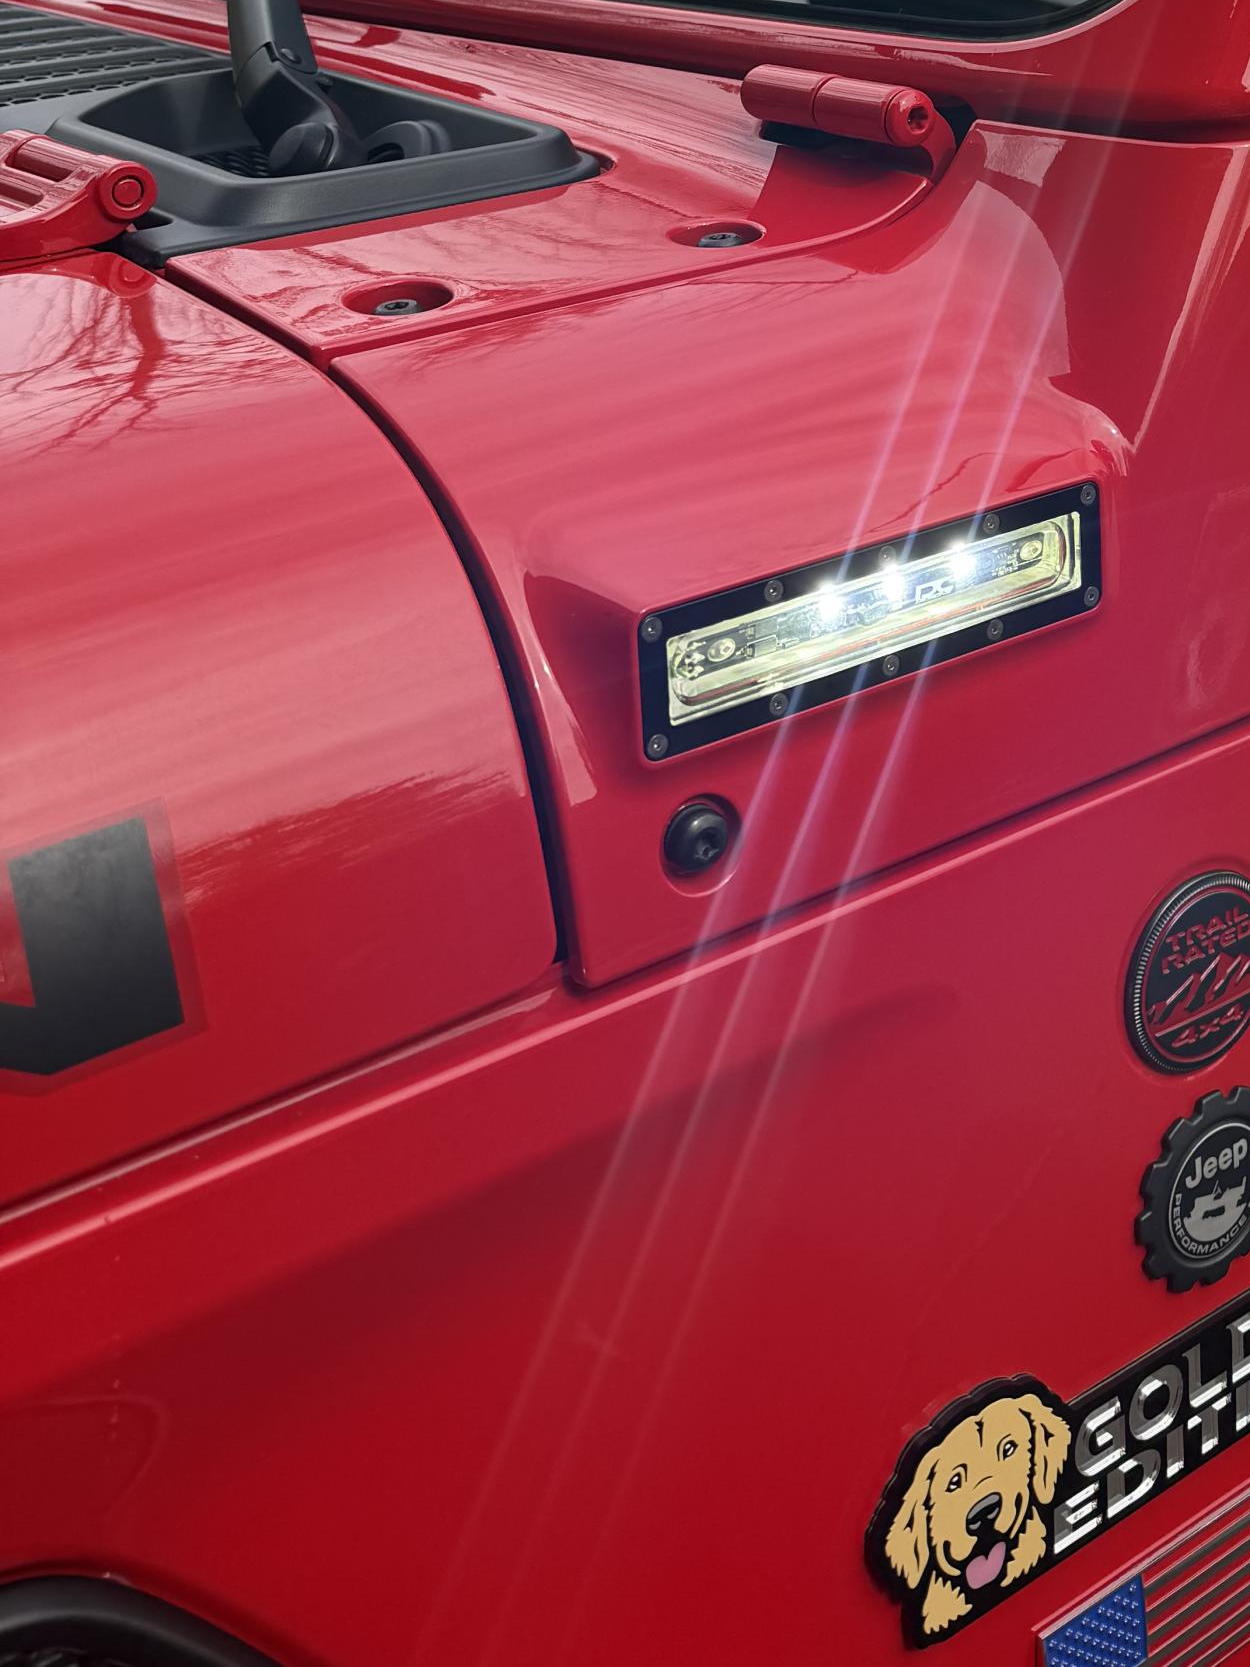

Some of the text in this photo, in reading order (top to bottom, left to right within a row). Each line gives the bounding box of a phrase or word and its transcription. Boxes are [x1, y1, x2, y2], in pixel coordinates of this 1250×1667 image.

[1166, 905, 1250, 950] TRAIL
[1185, 1137, 1248, 1189] Jeep
[1172, 1193, 1248, 1255] PERFORMANCE
